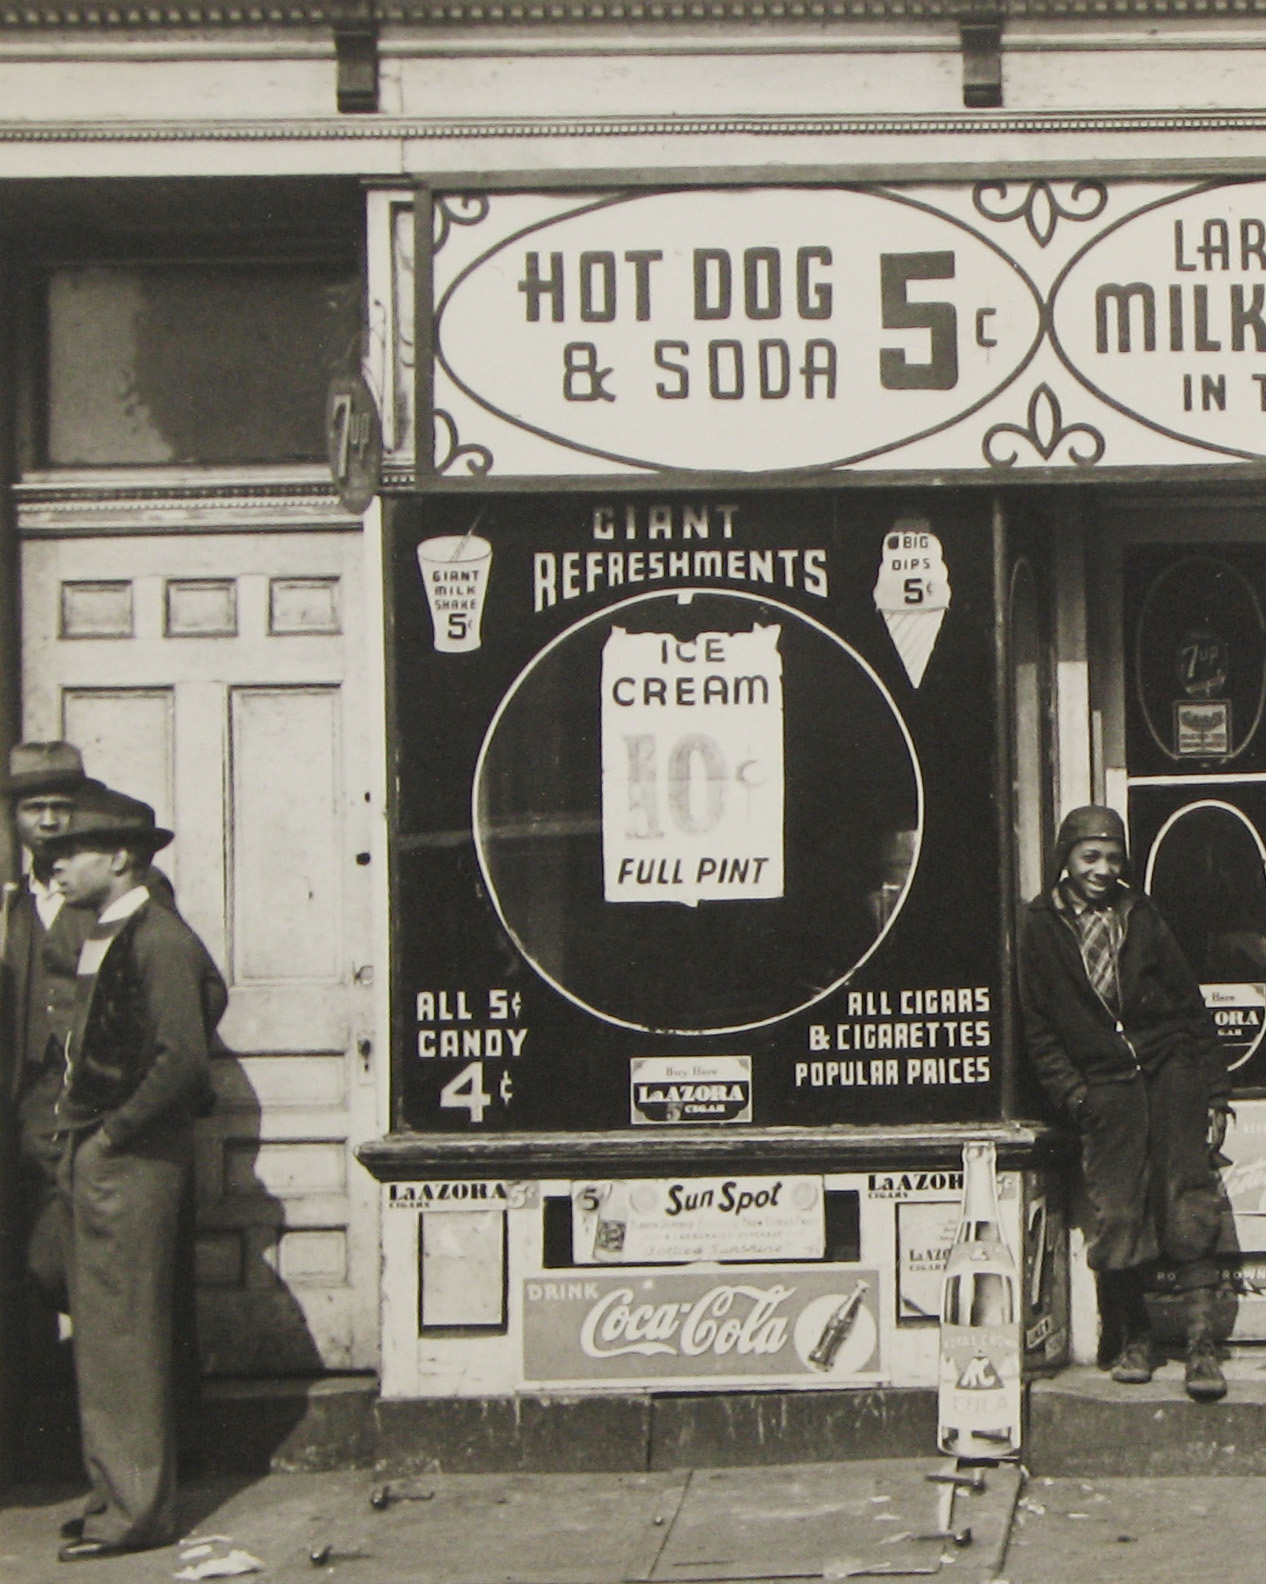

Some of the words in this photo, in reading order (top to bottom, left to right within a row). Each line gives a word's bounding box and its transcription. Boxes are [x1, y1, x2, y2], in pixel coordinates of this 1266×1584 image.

[518, 249, 663, 323] HOT
[693, 246, 832, 321] DOG
[562, 341, 616, 403] &
[654, 337, 838, 401] SODA
[1184, 373, 1227, 412] IN
[592, 503, 740, 541] GIANT
[902, 535, 929, 549] BIG
[432, 569, 480, 582] GIANT
[891, 557, 931, 572] DIPS
[533, 547, 829, 614] REFRESHMENTS
[660, 638, 726, 665] ICE
[612, 674, 770, 707] CREAM
[617, 857, 684, 886] FULL
[695, 856, 770, 885] PINT
[416, 991, 473, 1021] ALL
[847, 990, 893, 1016] ALL
[900, 986, 991, 1015] CIGARS
[418, 1027, 529, 1058] CANDY
[809, 1024, 831, 1051] &
[836, 1020, 991, 1050] CIGARETTES
[795, 1058, 899, 1087] POPULAR
[906, 1055, 991, 1085] PRICES
[664, 1183, 715, 1217] Sun
[717, 1180, 783, 1216] Spot
[1216, 1268, 1266, 1281] ROWN
[526, 1281, 600, 1301] DRINK
[580, 1283, 798, 1358] Coca-Cola
